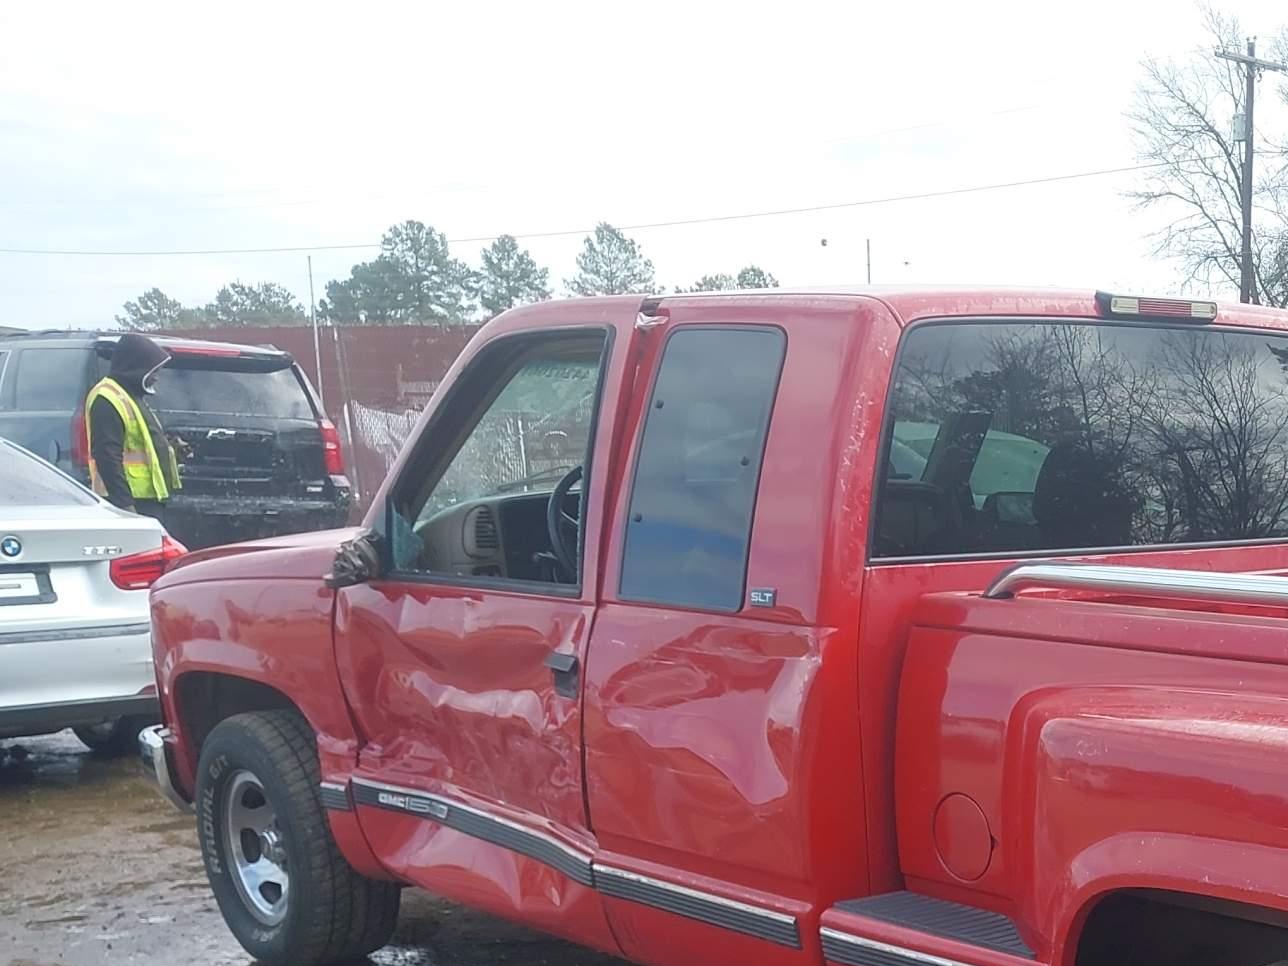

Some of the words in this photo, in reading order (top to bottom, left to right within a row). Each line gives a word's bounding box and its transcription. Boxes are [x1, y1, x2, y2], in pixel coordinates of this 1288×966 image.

[750, 591, 773, 603] SLT
[208, 754, 229, 780] G/T
[202, 786, 222, 874] RADIAL
